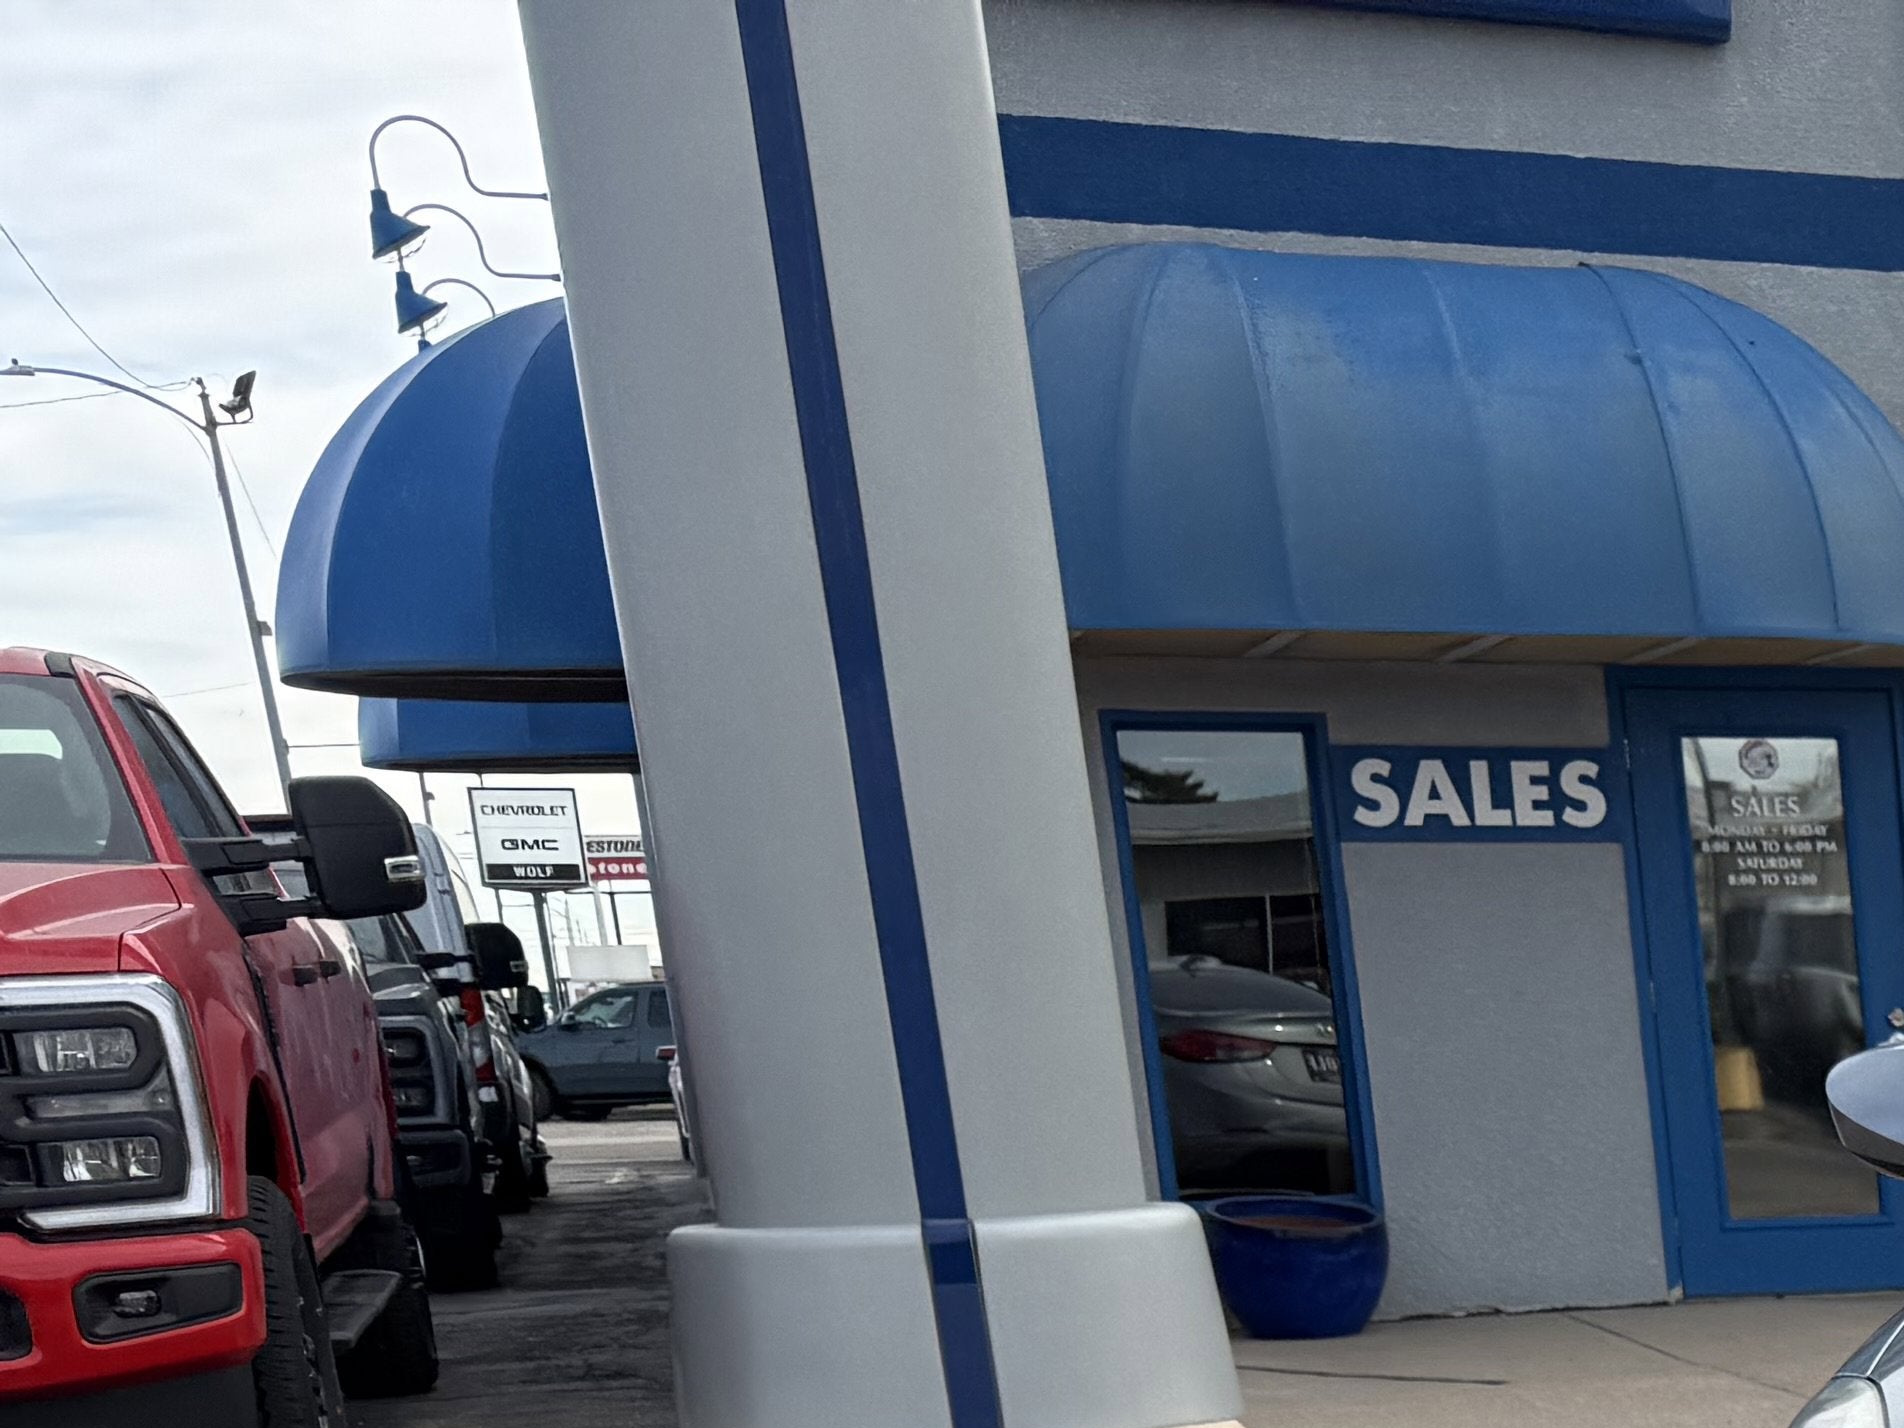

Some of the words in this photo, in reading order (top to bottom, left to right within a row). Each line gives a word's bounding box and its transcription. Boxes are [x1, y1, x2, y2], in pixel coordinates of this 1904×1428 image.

[1351, 758, 1607, 828] SALES
[481, 804, 568, 817] CHEVROLET
[1731, 796, 1801, 818] SALES
[1708, 824, 1766, 837] MONDAY
[1782, 823, 1829, 837] FRIDAY
[501, 838, 560, 852] GMC
[1736, 841, 1758, 853] AM
[1761, 841, 1781, 853] TO
[1816, 841, 1838, 853] PM
[1738, 857, 1803, 870] SATURDAY
[512, 865, 555, 878] WOLF
[1761, 873, 1781, 886] TO
[1782, 873, 1819, 886] 12:00
